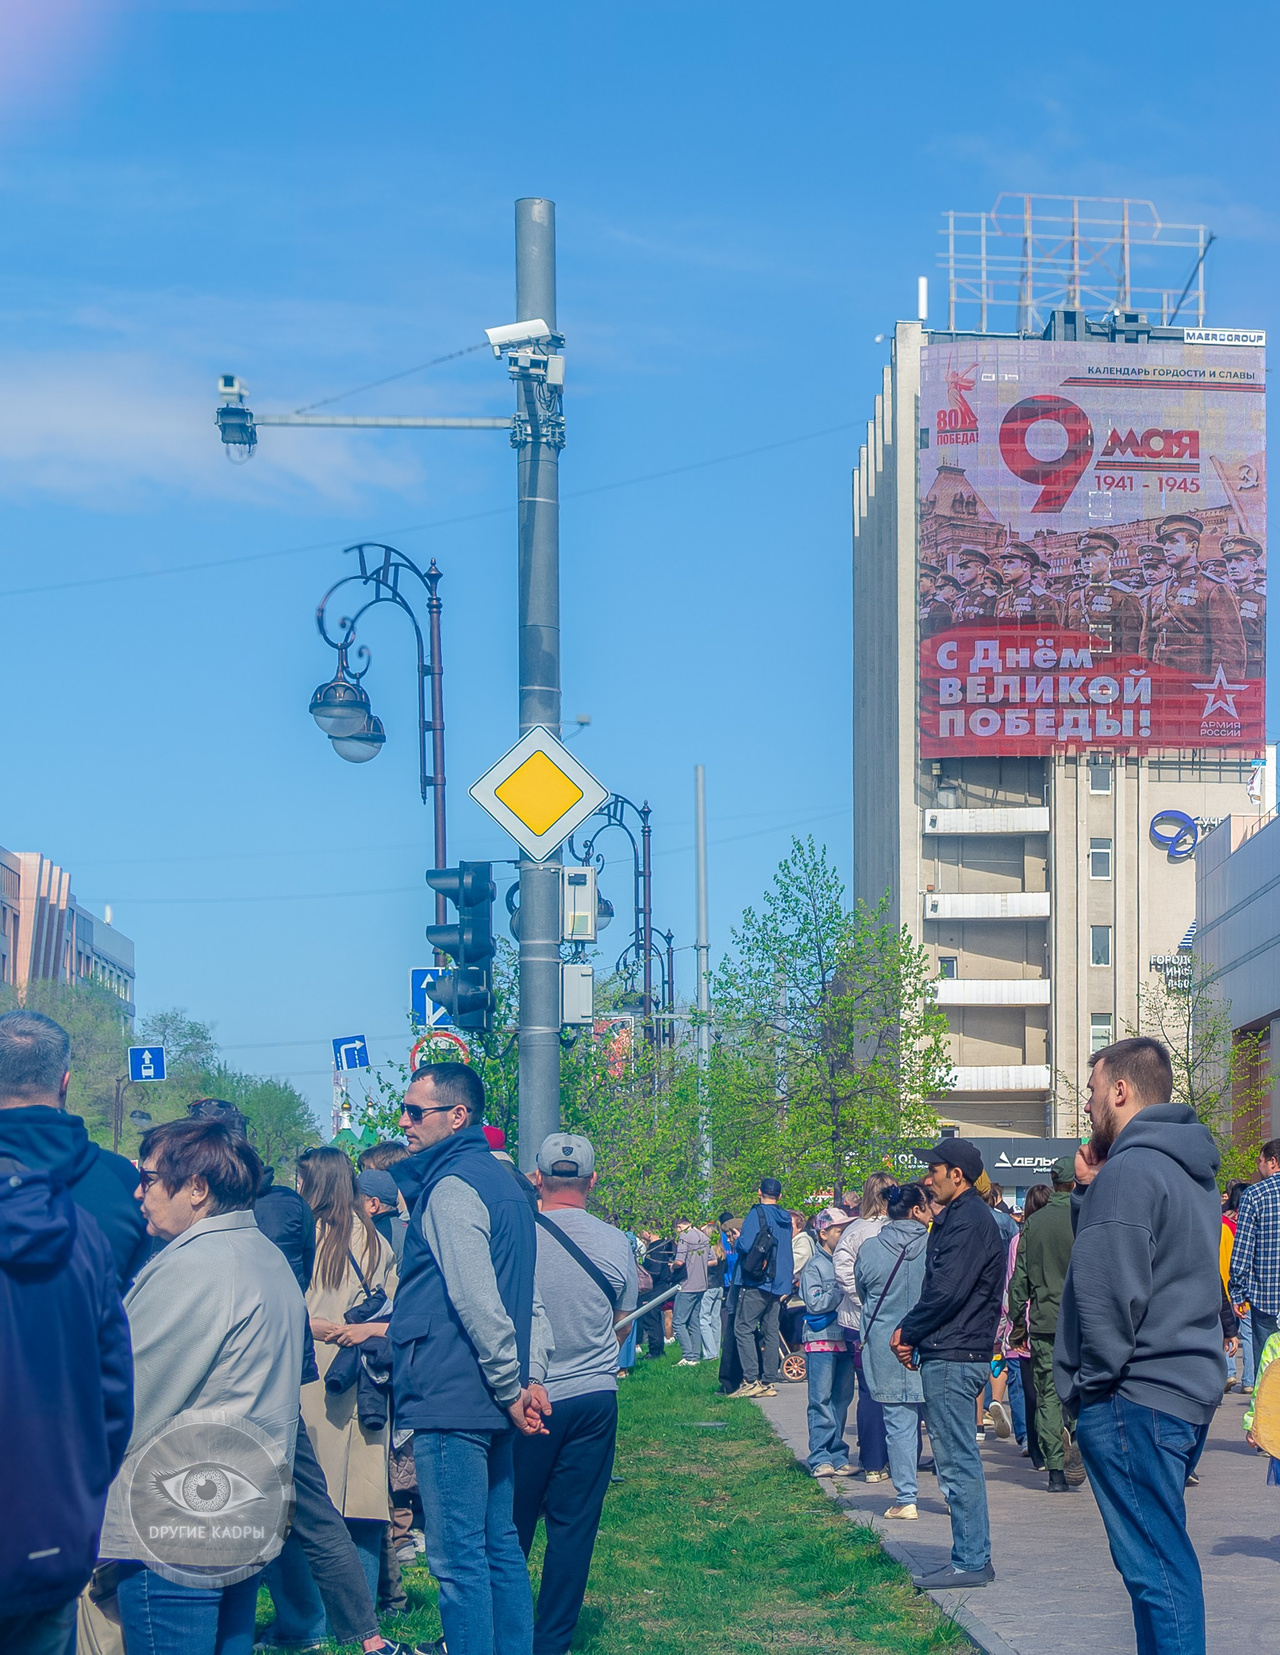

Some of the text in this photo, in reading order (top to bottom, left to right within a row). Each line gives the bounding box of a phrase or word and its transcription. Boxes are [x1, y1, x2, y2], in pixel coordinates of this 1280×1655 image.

[1087, 366, 1256, 380] КАЛЕНДАРЬ ГОРДОСТИ И СЛАВЫ
[936, 409, 959, 431] 80
[936, 432, 979, 446] ПОБЕДА!
[999, 394, 1094, 514] 9
[1095, 475, 1134, 491] 1941
[1157, 476, 1201, 493] 1945
[936, 638, 1093, 673] С Днём
[939, 668, 1152, 705] ВЕЛИКОЙ
[938, 708, 1152, 741] ПОБЕДЫ!
[1200, 721, 1241, 729] АРМИЯ
[1200, 729, 1241, 737] РОССИИ
